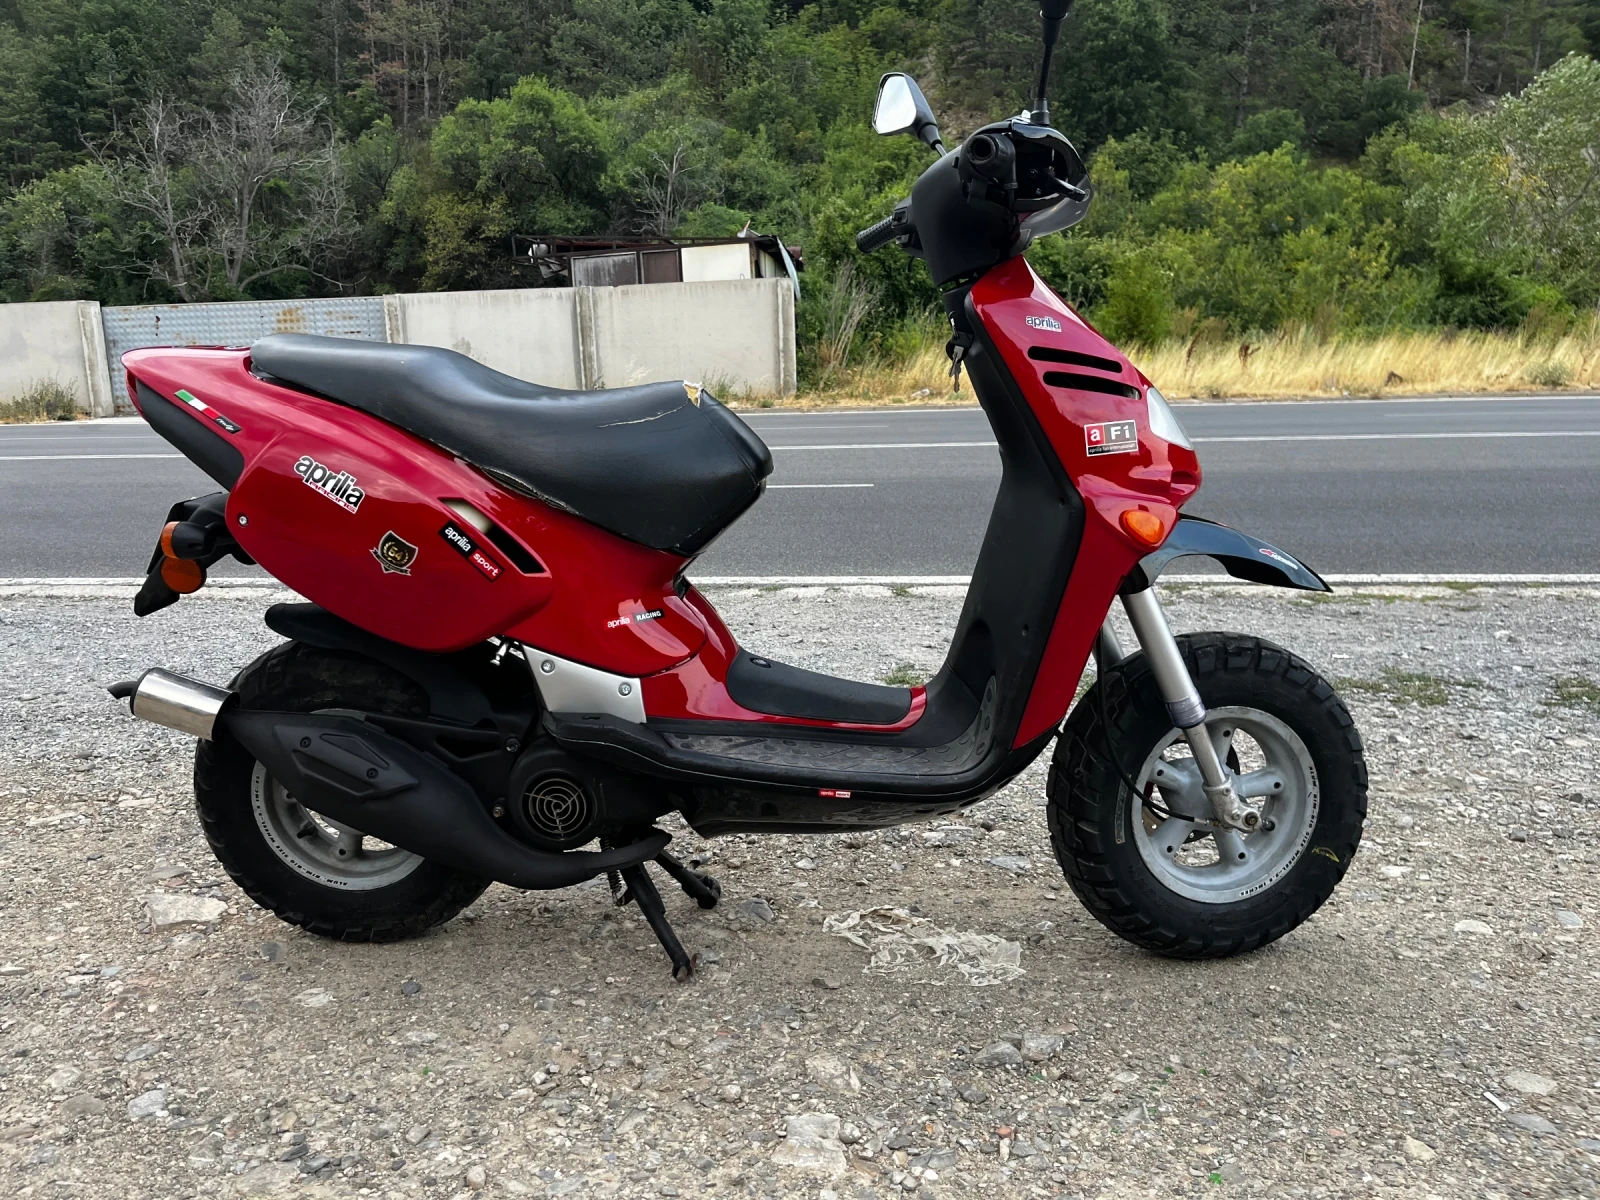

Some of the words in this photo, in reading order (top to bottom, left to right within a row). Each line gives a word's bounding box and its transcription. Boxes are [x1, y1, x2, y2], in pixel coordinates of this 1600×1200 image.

[1026, 316, 1060, 329] aprilia
[1090, 428, 1100, 441] a
[1110, 425, 1130, 440] F1
[295, 455, 365, 508] aprilia
[444, 526, 471, 552] aprilia
[473, 553, 499, 577] sport
[607, 616, 630, 628] aprilia
[636, 610, 662, 621] RACING
[1240, 881, 1267, 896] INCHES
